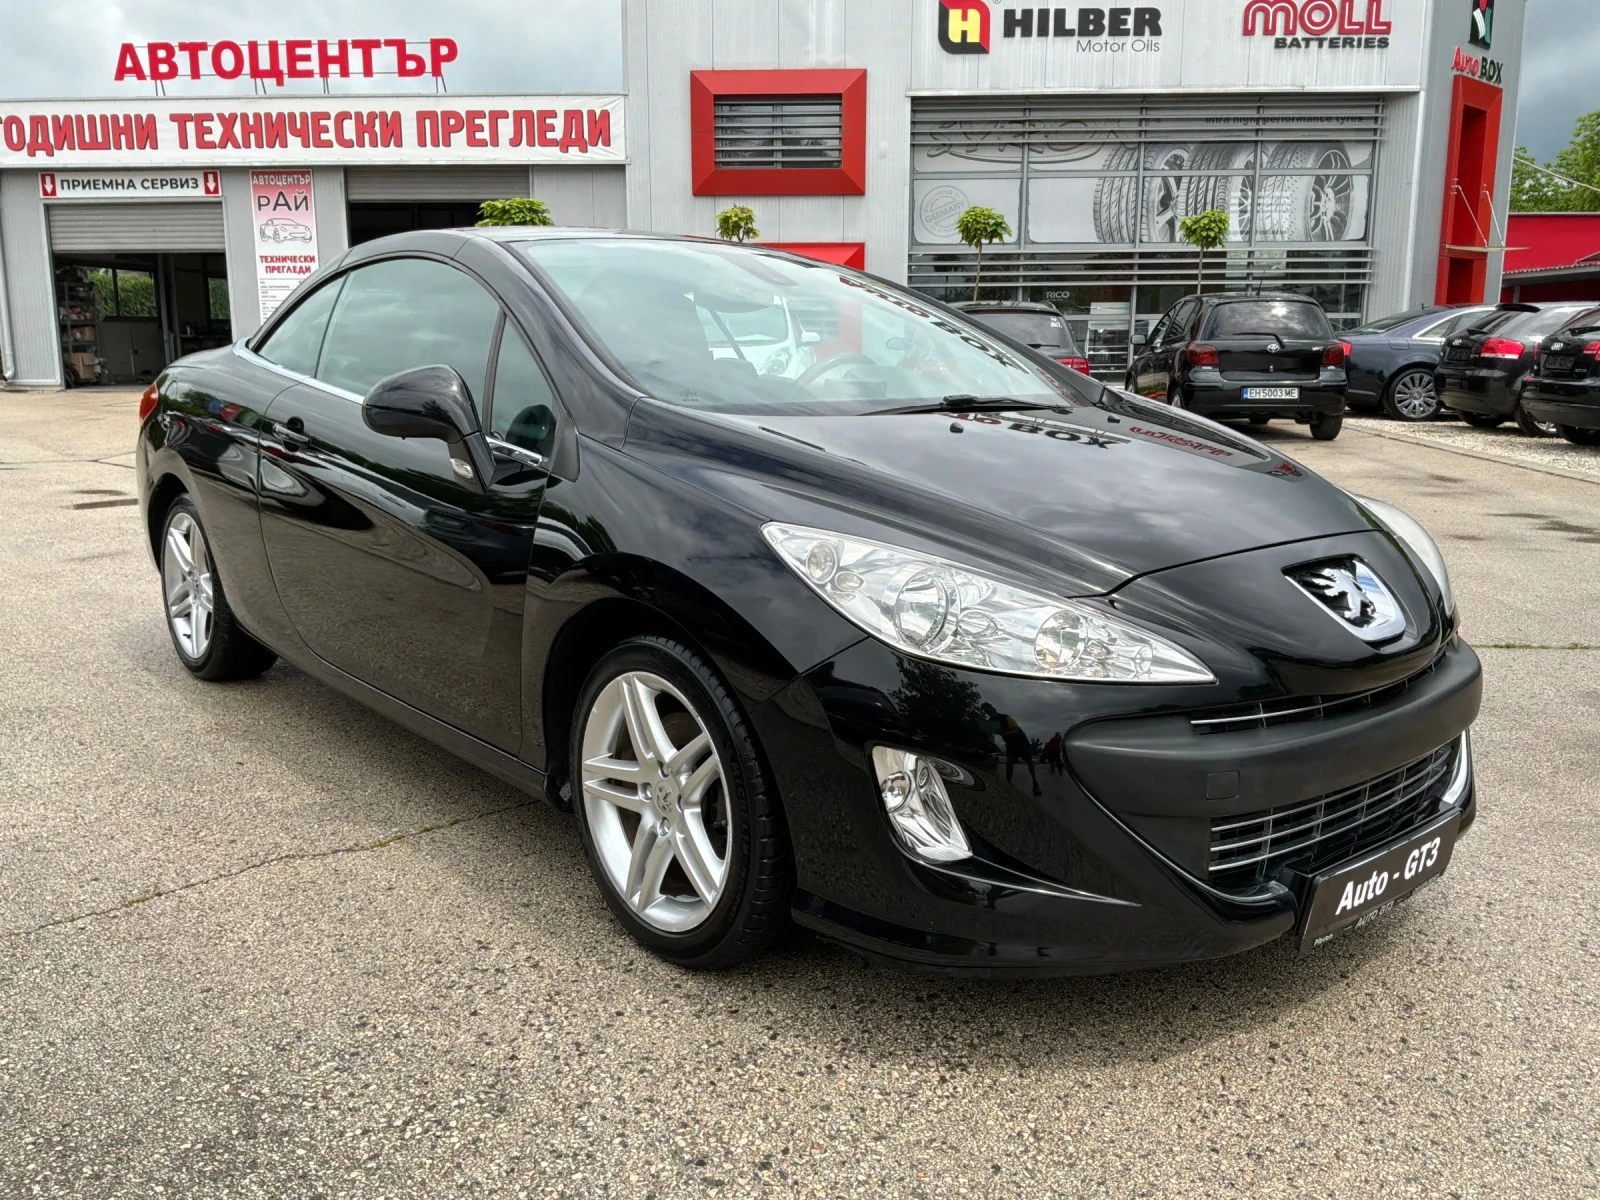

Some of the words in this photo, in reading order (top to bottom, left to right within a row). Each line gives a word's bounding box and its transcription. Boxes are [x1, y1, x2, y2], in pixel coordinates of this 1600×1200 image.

[1003, 7, 1162, 38] HILBER
[1076, 39, 1127, 53] Motor
[1131, 38, 1160, 53] Oils
[1274, 37, 1390, 49] BATTERIES
[114, 37, 459, 87] АВТОЦЕНТЪР
[1478, 56, 1503, 84] BOX
[0, 114, 158, 157] ОДИШНИ
[169, 111, 403, 150] ТЕХНИЧЕСКИ
[416, 109, 611, 153] ПРЕГЛЕДИ
[60, 179, 138, 190] ПРИЕМНА
[140, 177, 199, 190] СЕРВИЗ
[253, 174, 311, 186] АВТОЦЕНТЪР
[925, 199, 965, 223] GERMANY
[259, 255, 316, 264] ТЕХНИЧЕСКИ
[265, 265, 312, 275] ПРЕГЛЕДИ
[1335, 870, 1388, 916] Auto
[1404, 836, 1441, 880] GT3
